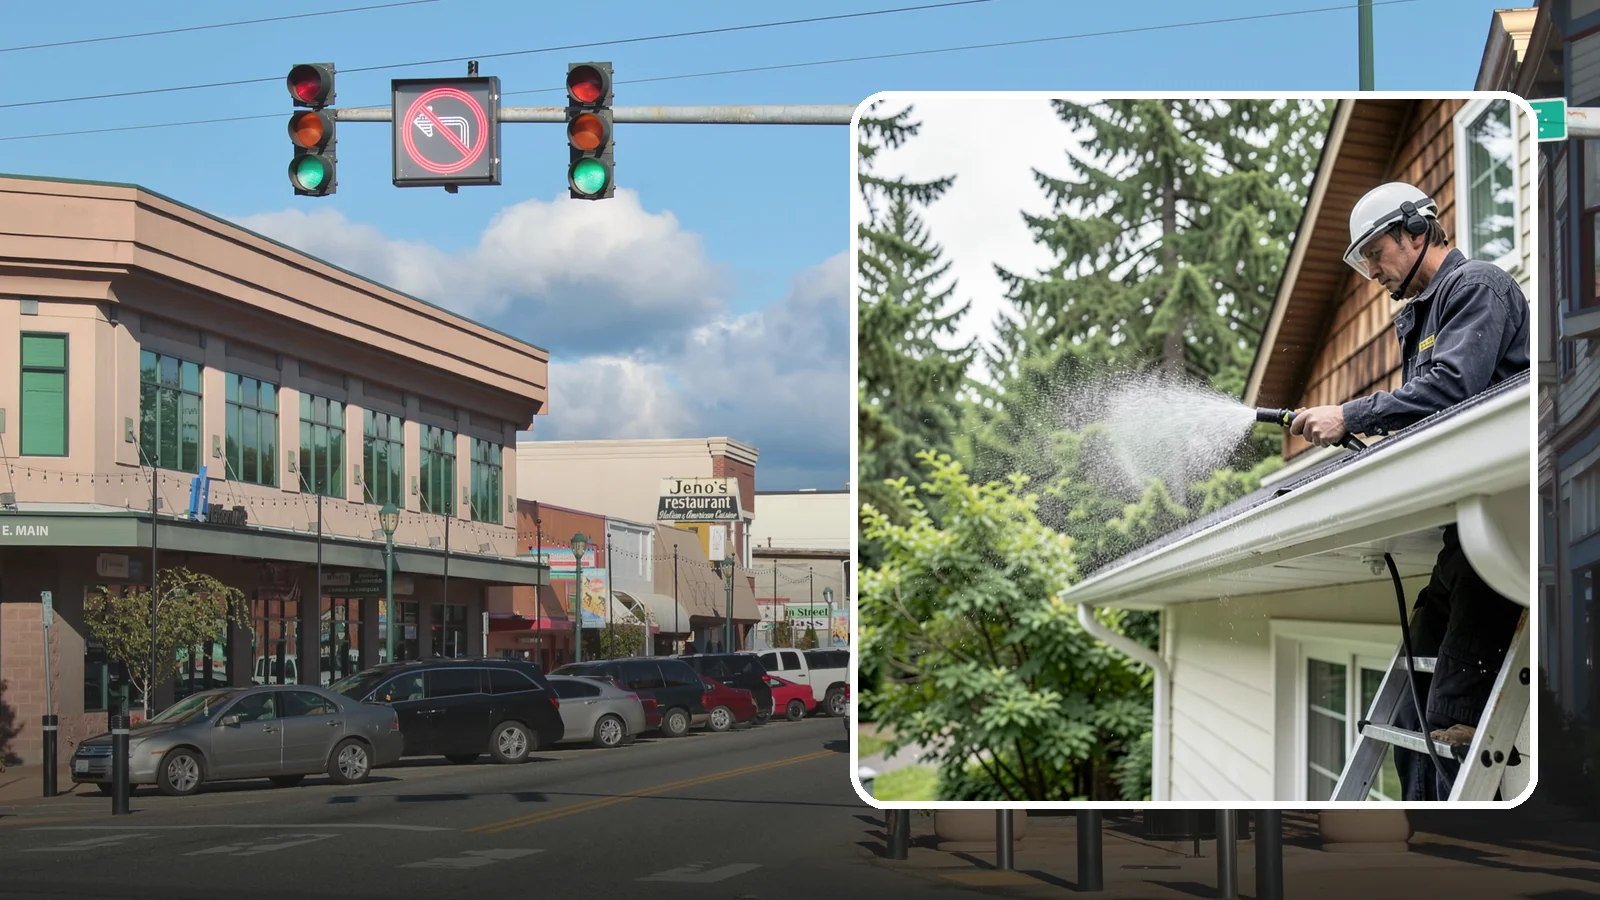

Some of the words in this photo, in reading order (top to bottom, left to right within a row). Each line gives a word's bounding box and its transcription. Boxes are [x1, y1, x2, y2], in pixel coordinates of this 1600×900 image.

[670, 480, 727, 495] Jeno's
[665, 496, 731, 509] restaurant
[659, 510, 681, 520] Italian
[686, 510, 714, 519] American
[715, 509, 737, 519] Cuisine
[2, 525, 13, 536] E.
[15, 525, 49, 536] MAIN
[797, 607, 828, 617] Street
